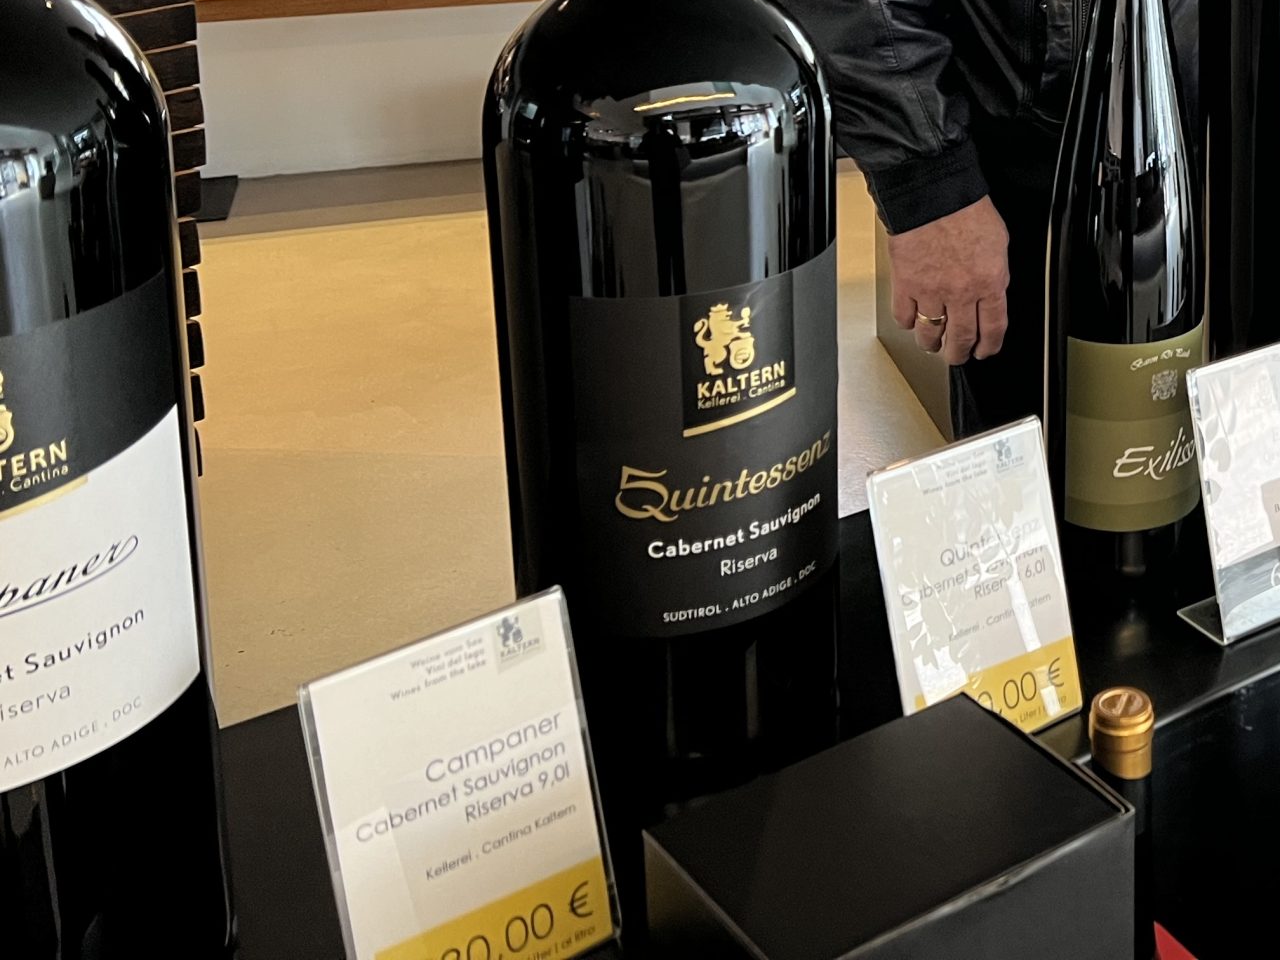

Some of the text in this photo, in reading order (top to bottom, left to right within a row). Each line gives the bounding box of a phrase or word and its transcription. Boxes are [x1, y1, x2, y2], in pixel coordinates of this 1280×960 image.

[697, 360, 785, 400] KALTERN
[697, 379, 786, 411] Kellerei Cantina
[1112, 426, 1197, 481] Exiliss
[10, 464, 69, 492] Cantina
[615, 431, 832, 522] Quintessenz
[648, 493, 821, 559] Cabernet Sauvignon
[720, 547, 778, 577] Riserva
[732, 592, 759, 610] ALTO
[762, 576, 792, 599] ADIGE
[986, 606, 1018, 627] Cantin
[1025, 592, 1051, 611] altern
[25, 608, 144, 674] Sauvignon
[500, 637, 541, 659] KALTERN
[1048, 656, 1065, 687] €
[4, 695, 142, 769] ALTO ADIGE DOC
[425, 711, 563, 783] Campaner
[356, 741, 566, 843] Cabernet Sauvignon
[465, 782, 533, 824] Riserva
[426, 803, 577, 881] Kellerei Cantina Kaltern
[568, 880, 594, 918] €
